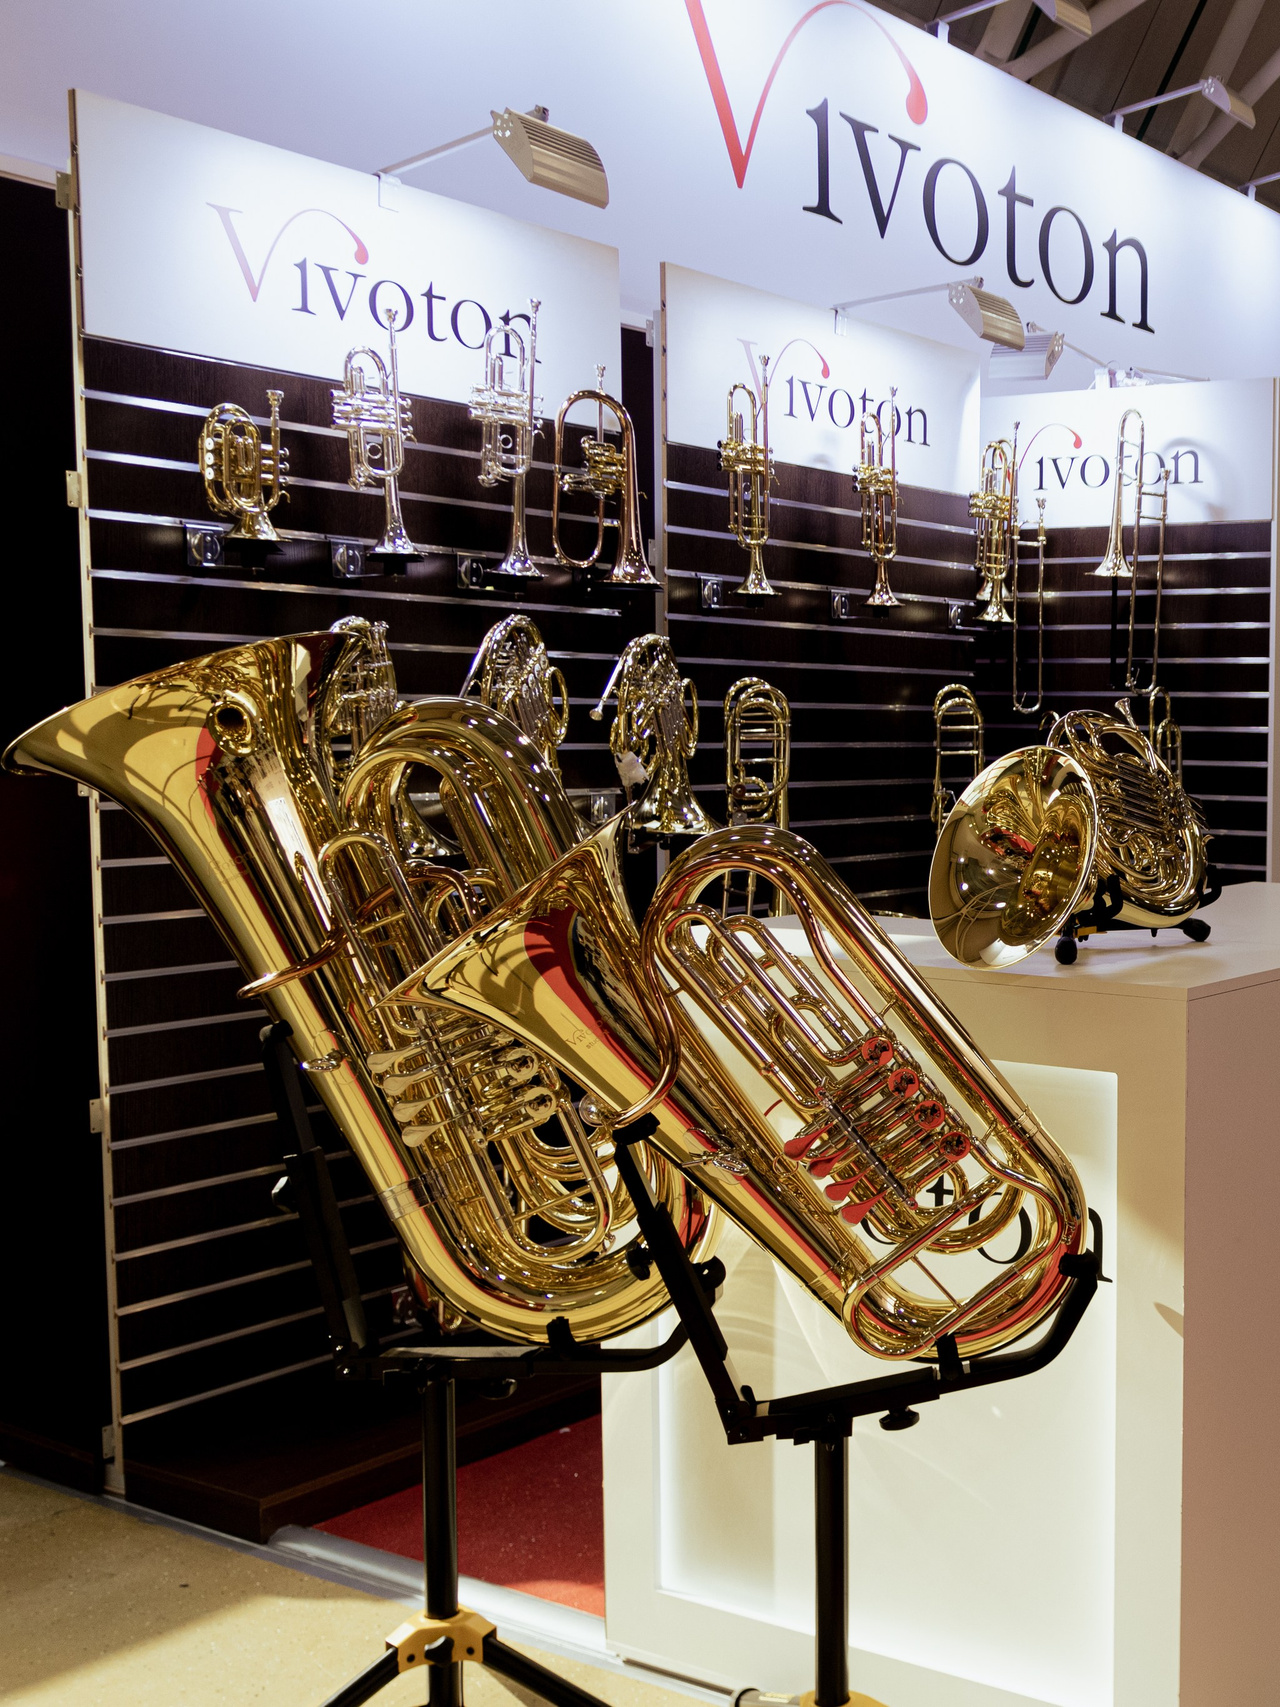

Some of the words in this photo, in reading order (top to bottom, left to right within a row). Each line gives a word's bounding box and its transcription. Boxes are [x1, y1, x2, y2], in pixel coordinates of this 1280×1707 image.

[685, 0, 1155, 334] Vivoton
[206, 202, 541, 364] Vivoton
[737, 338, 930, 447] Vivoton
